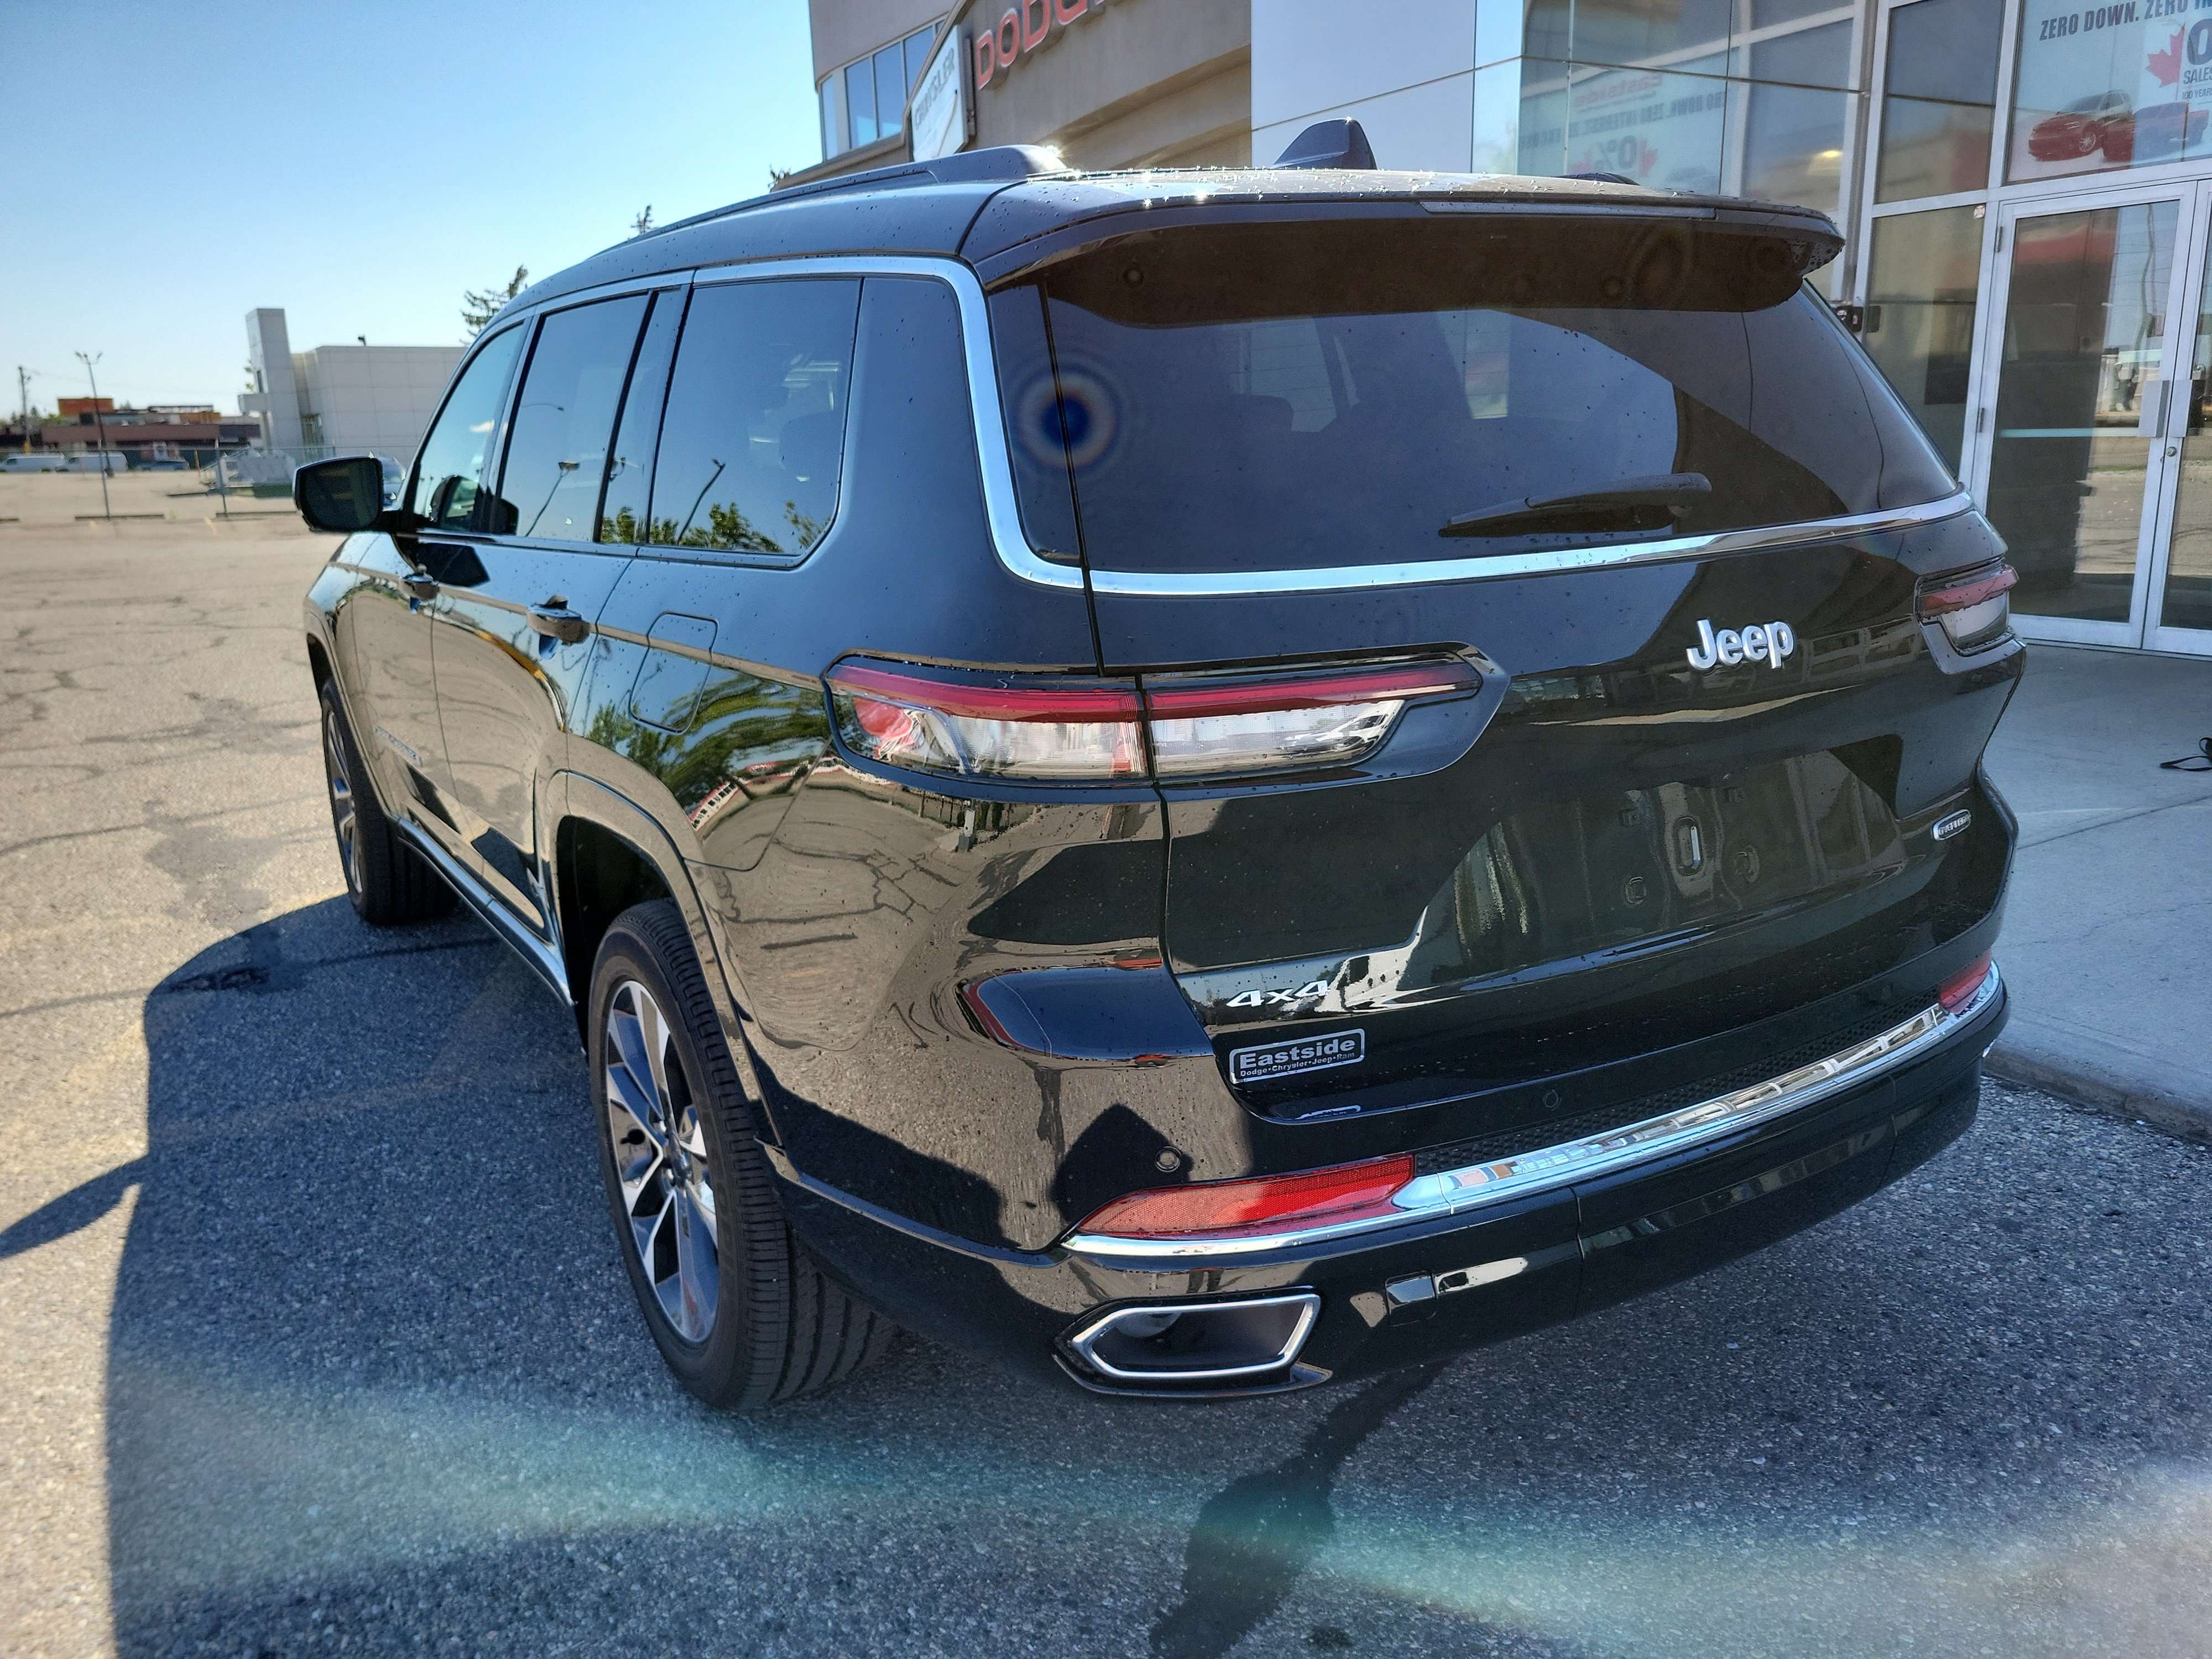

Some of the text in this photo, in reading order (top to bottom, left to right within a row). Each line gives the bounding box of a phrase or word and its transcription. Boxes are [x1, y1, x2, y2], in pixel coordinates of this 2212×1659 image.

[2039, 14, 2079, 41] ZERO
[2084, 1, 2138, 32] DOWN.
[976, 0, 1105, 90] DOD
[1686, 618, 1794, 670] Jeep
[1226, 980, 1331, 1007] 4x4
[1240, 1039, 1355, 1070] Eastside
